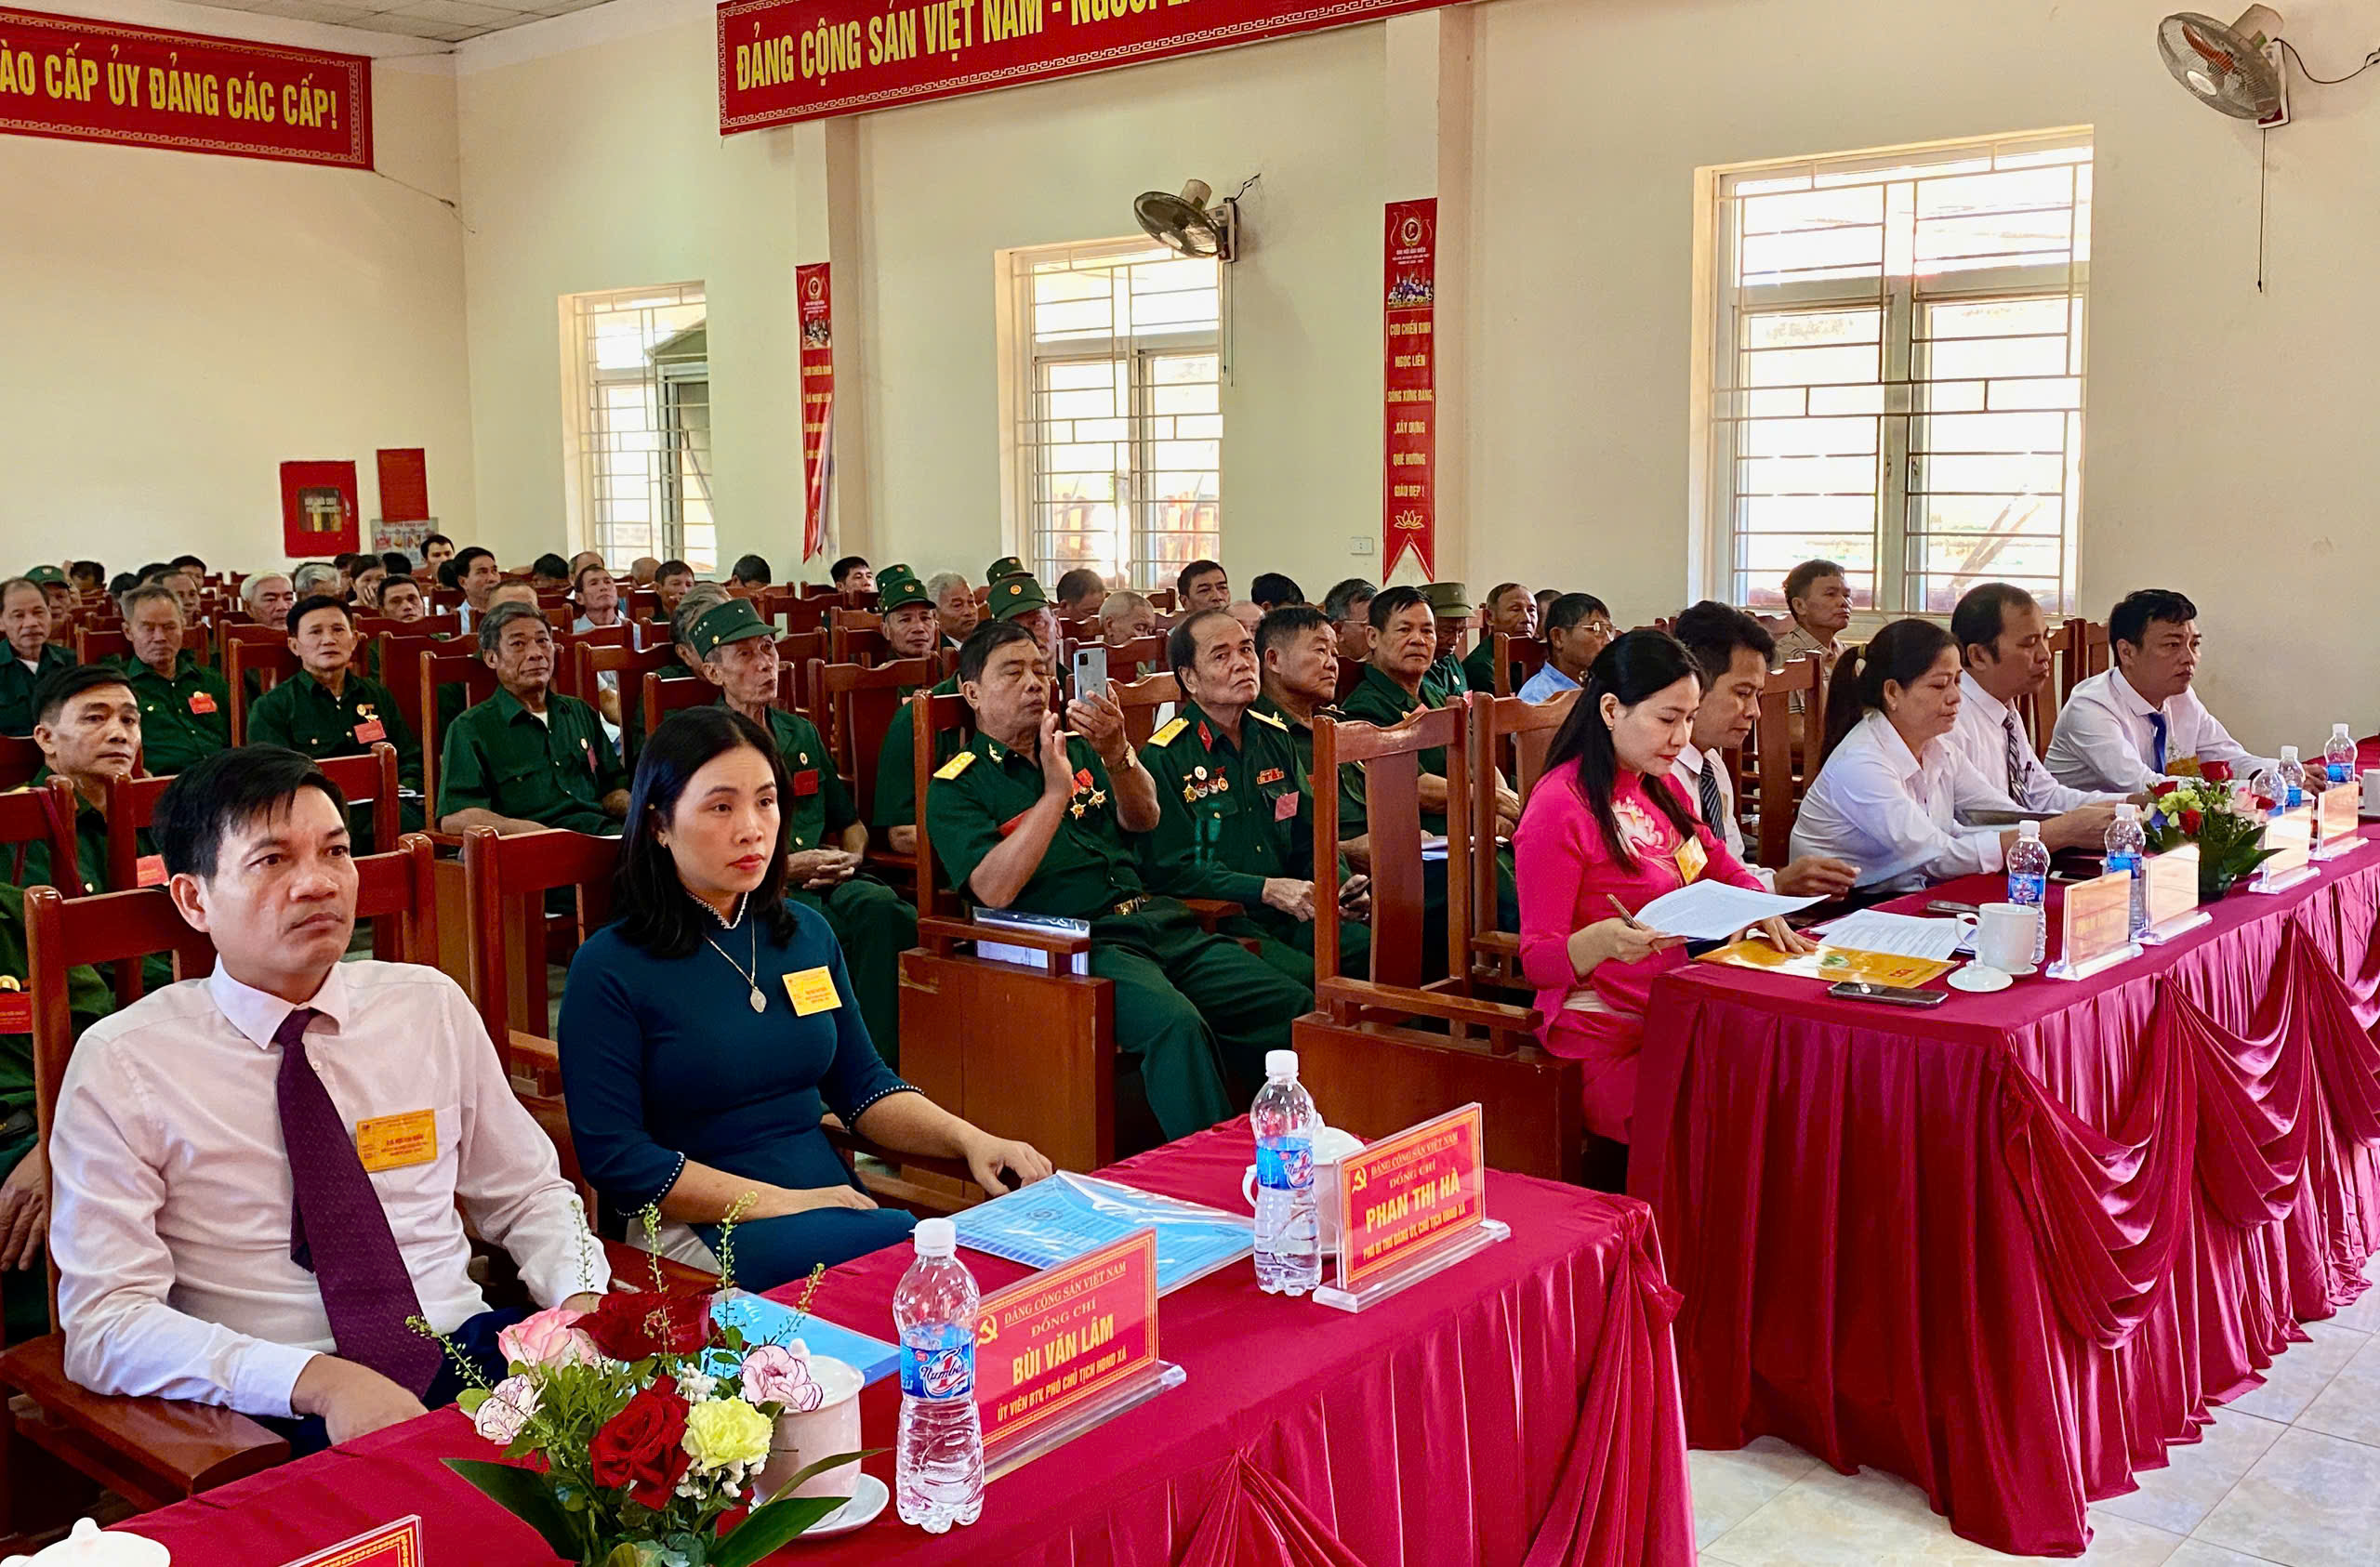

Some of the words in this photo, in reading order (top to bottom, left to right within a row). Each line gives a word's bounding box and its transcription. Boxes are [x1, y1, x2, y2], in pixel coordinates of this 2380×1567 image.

[736, 21, 795, 90] ĐẢNG
[800, 18, 862, 86] CỘNG
[868, 0, 918, 66] SẢN
[983, 0, 1043, 44] NAM
[45, 42, 99, 101] CẤP
[108, 44, 140, 107] ỦY
[149, 52, 219, 116] ĐẢNG
[227, 71, 275, 123] CÁC
[283, 72, 337, 130] CẤP!
[1366, 1192, 1408, 1233] PHAN
[1412, 1180, 1436, 1211] THỊ
[1440, 1166, 1461, 1200] HÀ
[1419, 1158, 1435, 1176] CHÍ
[1004, 1304, 1033, 1324] ĐẢNG
[1034, 1290, 1062, 1311] CỘNG
[1063, 1277, 1083, 1297] SẢN
[1082, 1269, 1104, 1287] VIỆT
[1106, 1261, 1127, 1279] NAM
[1030, 1310, 1069, 1338] ĐỒNG
[1072, 1296, 1097, 1318] CHÍ
[1012, 1346, 1041, 1386] BÙI
[1044, 1330, 1078, 1370] VĂN
[1081, 1313, 1114, 1353] LÂM
[998, 1401, 1009, 1423] ỦY
[1010, 1392, 1028, 1416] VIÊN
[1045, 1376, 1061, 1399] PHÓ
[1062, 1367, 1078, 1390] CHỦ
[1079, 1361, 1096, 1384] TỊCH
